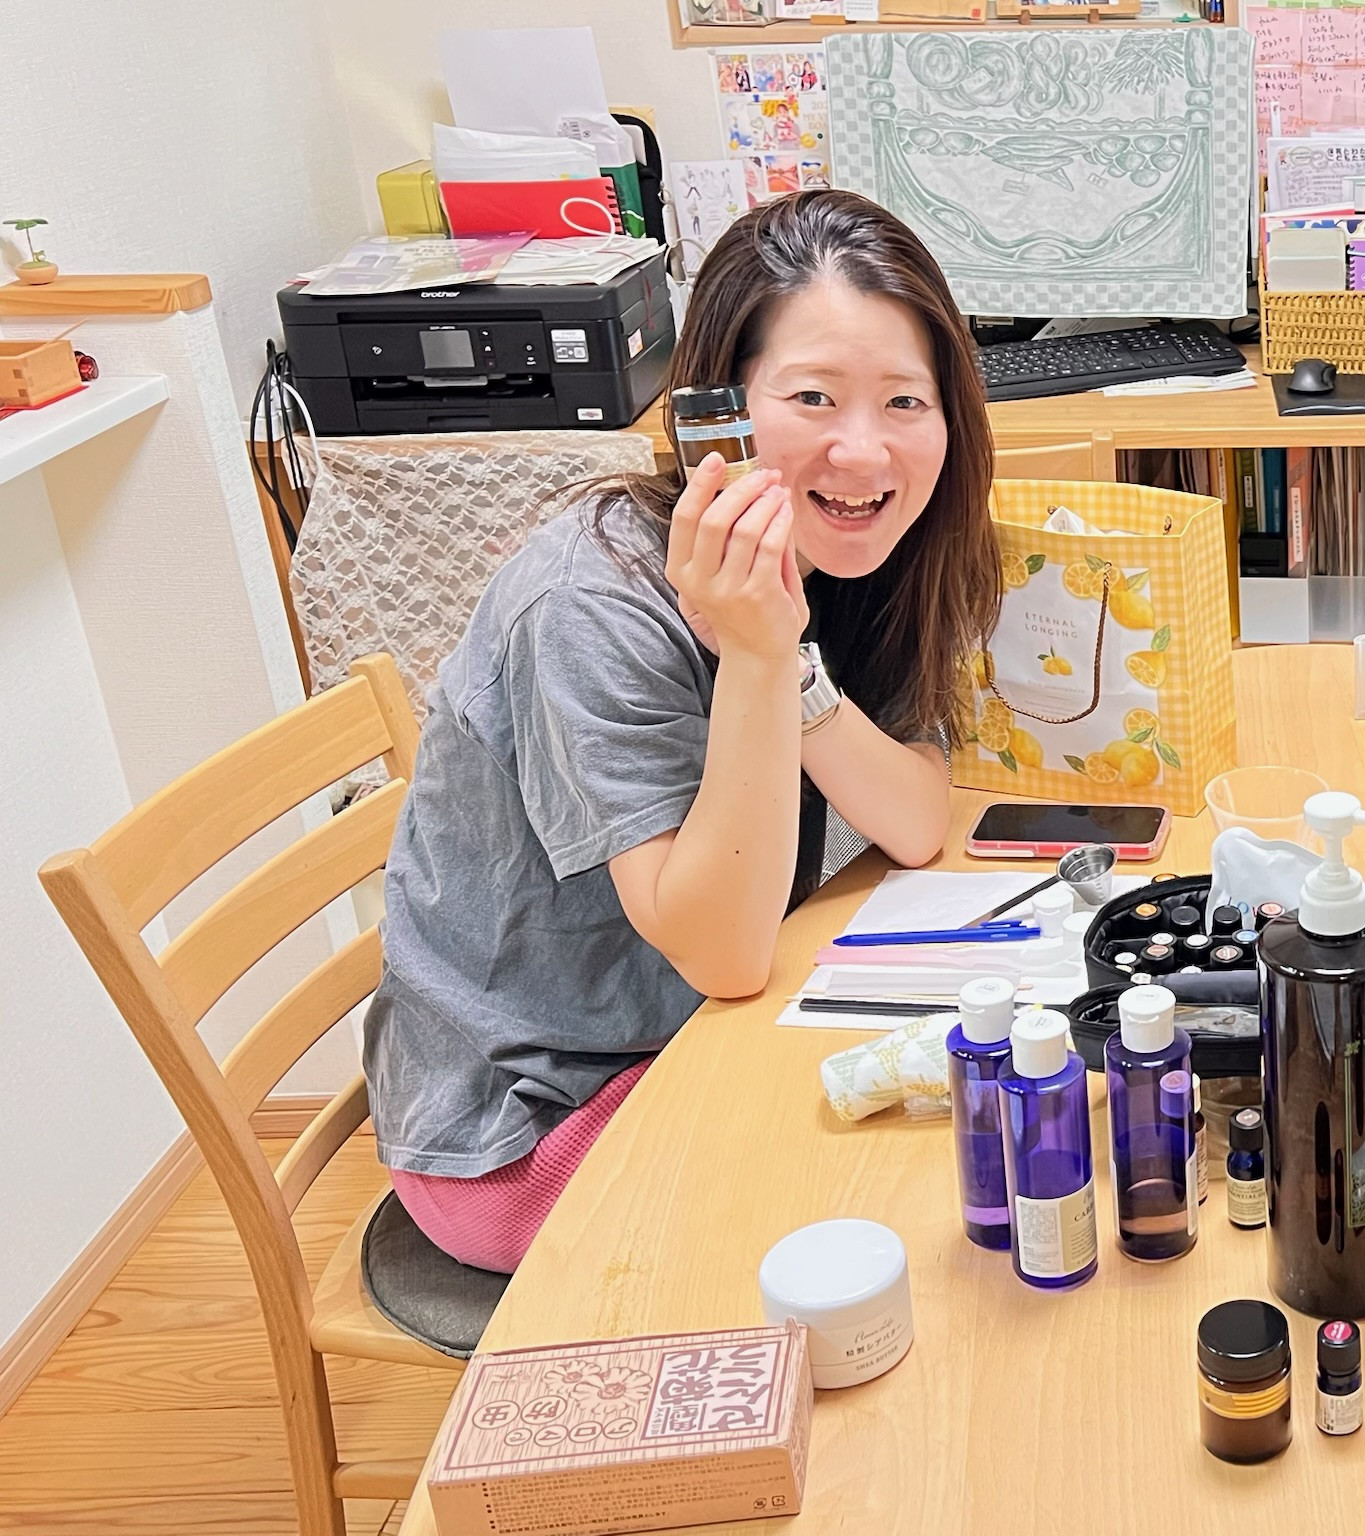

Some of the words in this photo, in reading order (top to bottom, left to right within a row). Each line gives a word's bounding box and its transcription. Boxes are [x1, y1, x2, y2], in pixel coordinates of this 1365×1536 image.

[1025, 612, 1076, 628] ETERNAL
[1025, 623, 1078, 639] LONGING
[856, 1361, 874, 1371] SHEA
[876, 1345, 898, 1363] BUTTER
[660, 1349, 722, 1405] 菊花
[709, 1344, 770, 1431] せんこう
[479, 1400, 560, 1426] 防虫
[510, 1422, 633, 1443] アロマで
